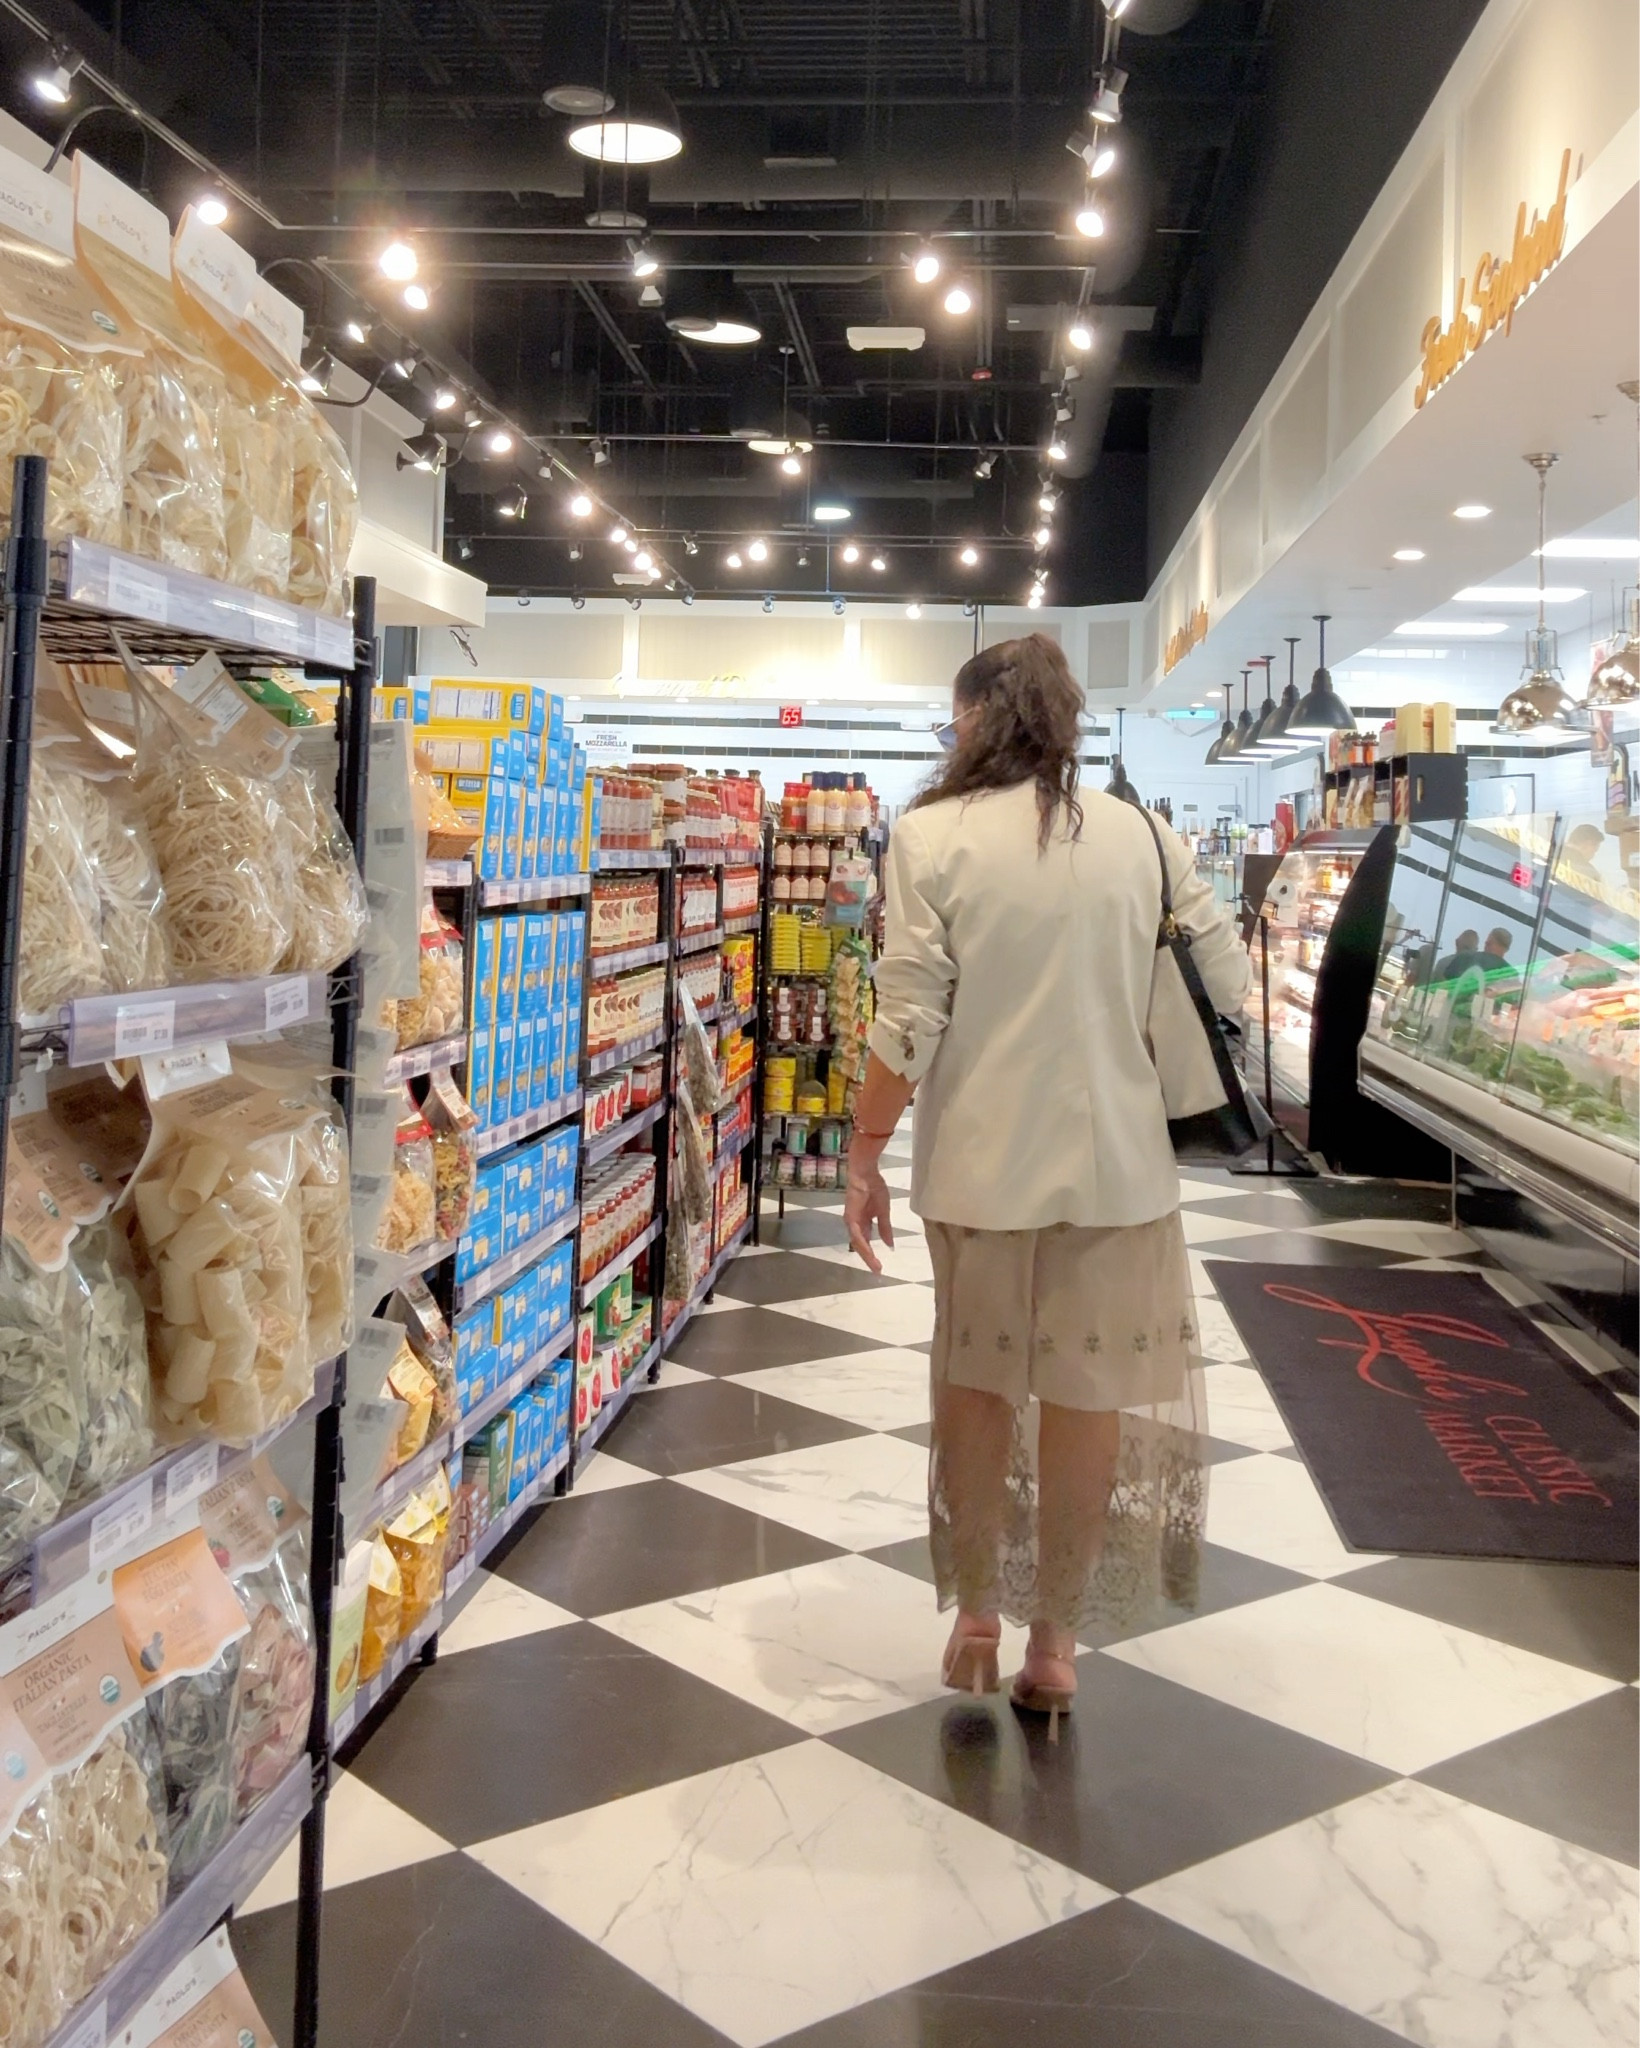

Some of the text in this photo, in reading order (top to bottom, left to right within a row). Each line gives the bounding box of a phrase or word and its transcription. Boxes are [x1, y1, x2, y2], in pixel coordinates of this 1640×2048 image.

[782, 709, 799, 725] 65
[585, 740, 628, 748] MOZZARELLA
[1417, 1409, 1540, 1505] MARKET
[1485, 1414, 1613, 1507] CLASSIC
[27, 1611, 67, 1643] PAOLO'S
[13, 1675, 59, 1713] ITALIAN
[59, 1654, 92, 1684] PASTA
[23, 1650, 75, 1690] ORGANIC
[166, 1977, 198, 2007] PAOLO'S
